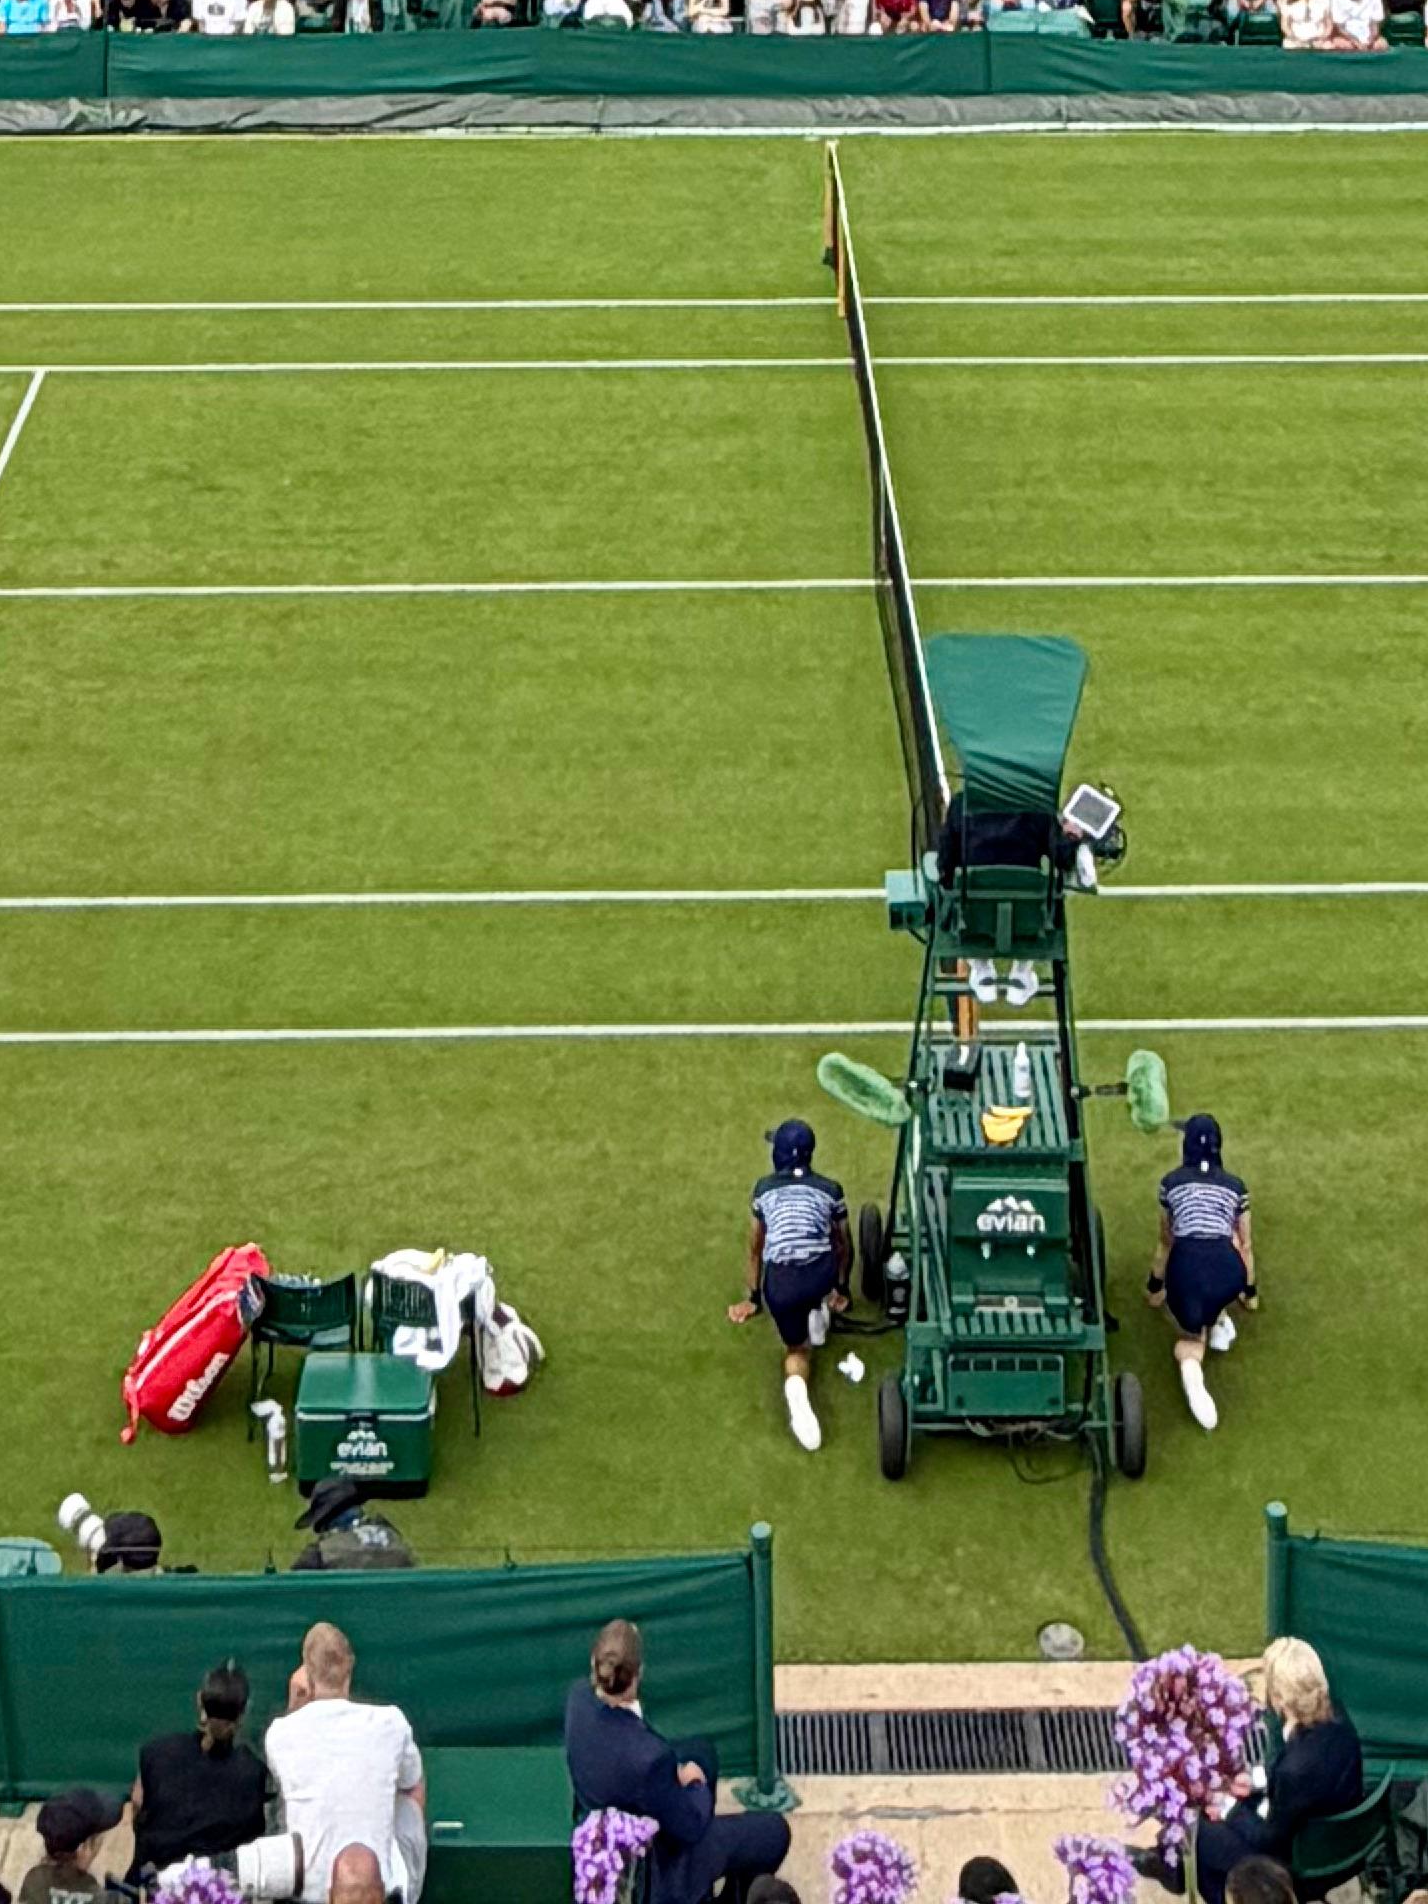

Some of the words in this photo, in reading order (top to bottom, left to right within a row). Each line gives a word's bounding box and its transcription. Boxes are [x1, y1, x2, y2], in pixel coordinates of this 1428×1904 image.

[976, 1211, 1046, 1233] evian
[166, 1352, 230, 1422] Wilson
[336, 1440, 389, 1458] evian
